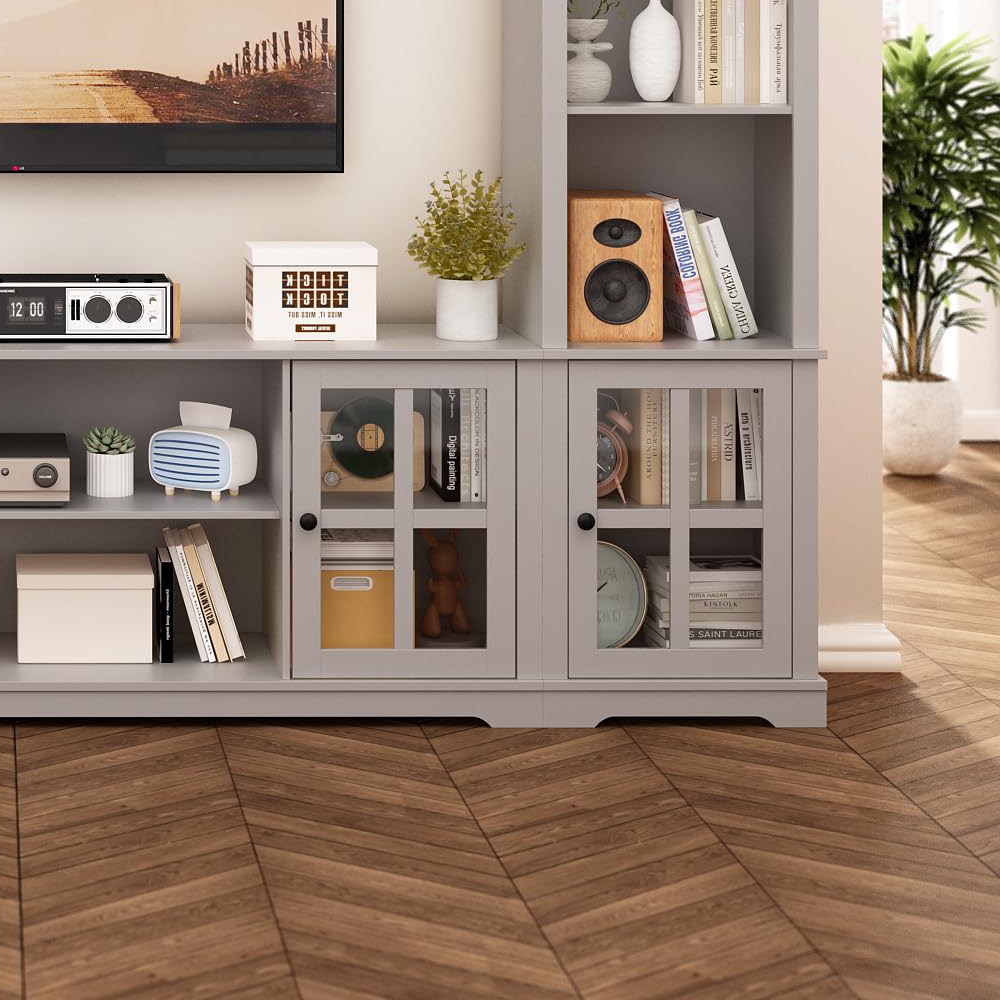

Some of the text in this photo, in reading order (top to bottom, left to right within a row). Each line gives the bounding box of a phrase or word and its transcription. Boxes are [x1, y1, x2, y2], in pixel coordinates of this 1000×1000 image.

[710, 68, 720, 86] РАЙ
[10, 302, 44, 317] 12 00
[724, 424, 733, 462] ASTRID
[446, 436, 457, 491] Digital painting
